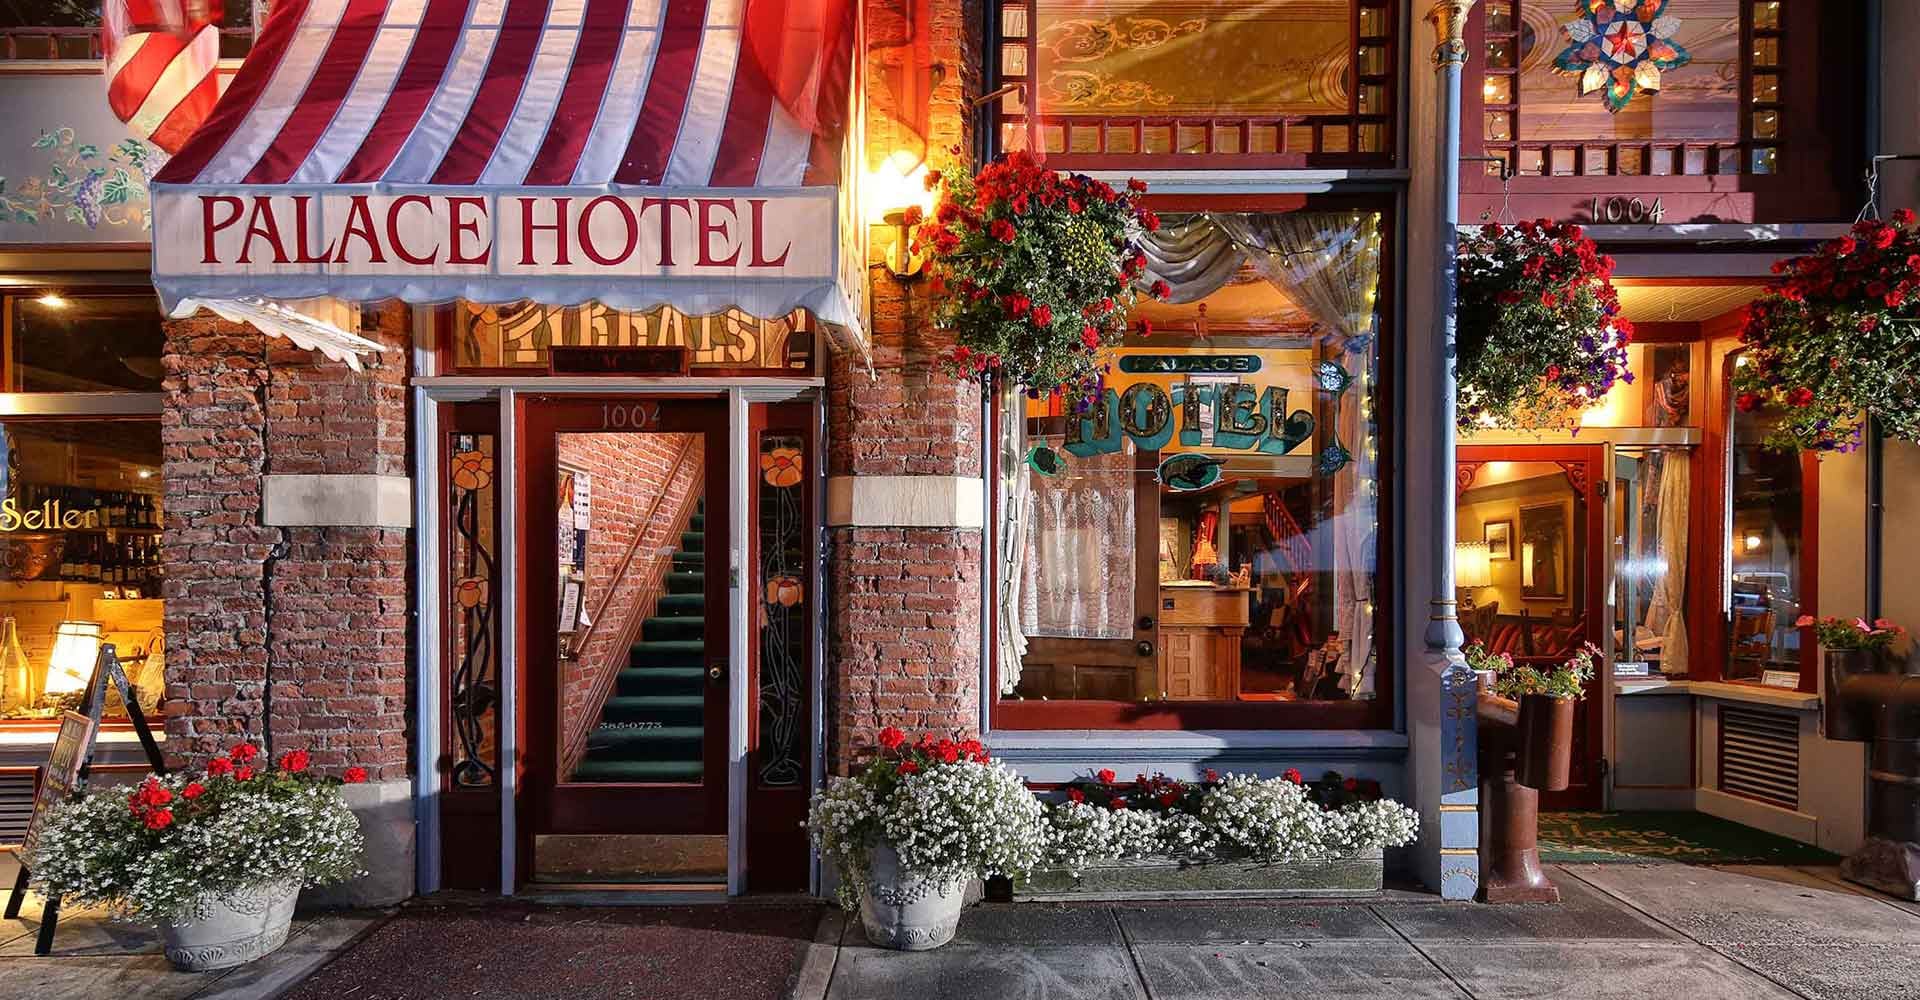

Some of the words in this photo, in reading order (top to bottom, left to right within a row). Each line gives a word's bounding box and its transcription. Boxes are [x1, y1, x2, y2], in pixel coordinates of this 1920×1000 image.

[1591, 194, 1666, 225] 1004
[198, 195, 493, 266] PALACE
[517, 195, 792, 267] HOTEL
[601, 400, 665, 432] 1004
[1064, 382, 1315, 457] HOTEL
[0, 497, 97, 531] Seller
